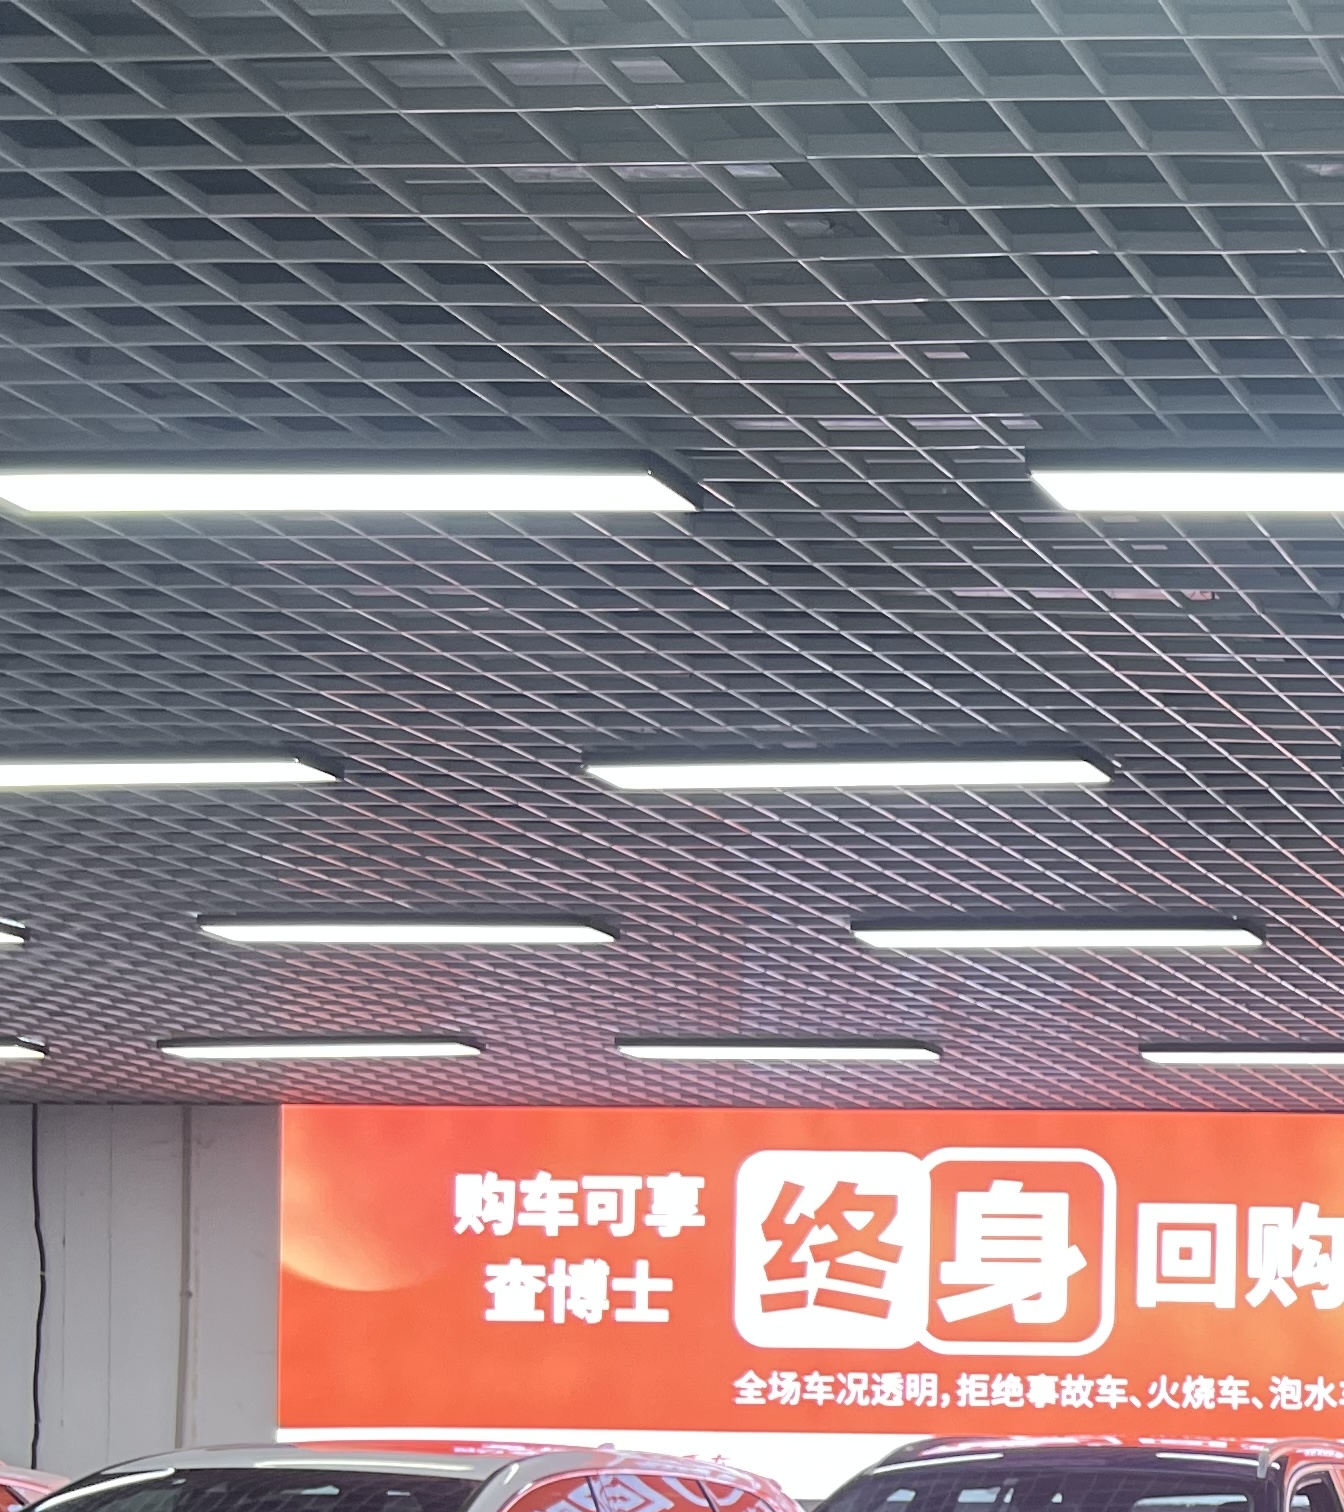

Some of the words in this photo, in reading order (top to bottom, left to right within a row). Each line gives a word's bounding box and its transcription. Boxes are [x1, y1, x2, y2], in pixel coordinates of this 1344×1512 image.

[453, 1172, 706, 1237] 购车可享
[760, 1179, 1087, 1325] 终身
[484, 1259, 674, 1324] 查博士
